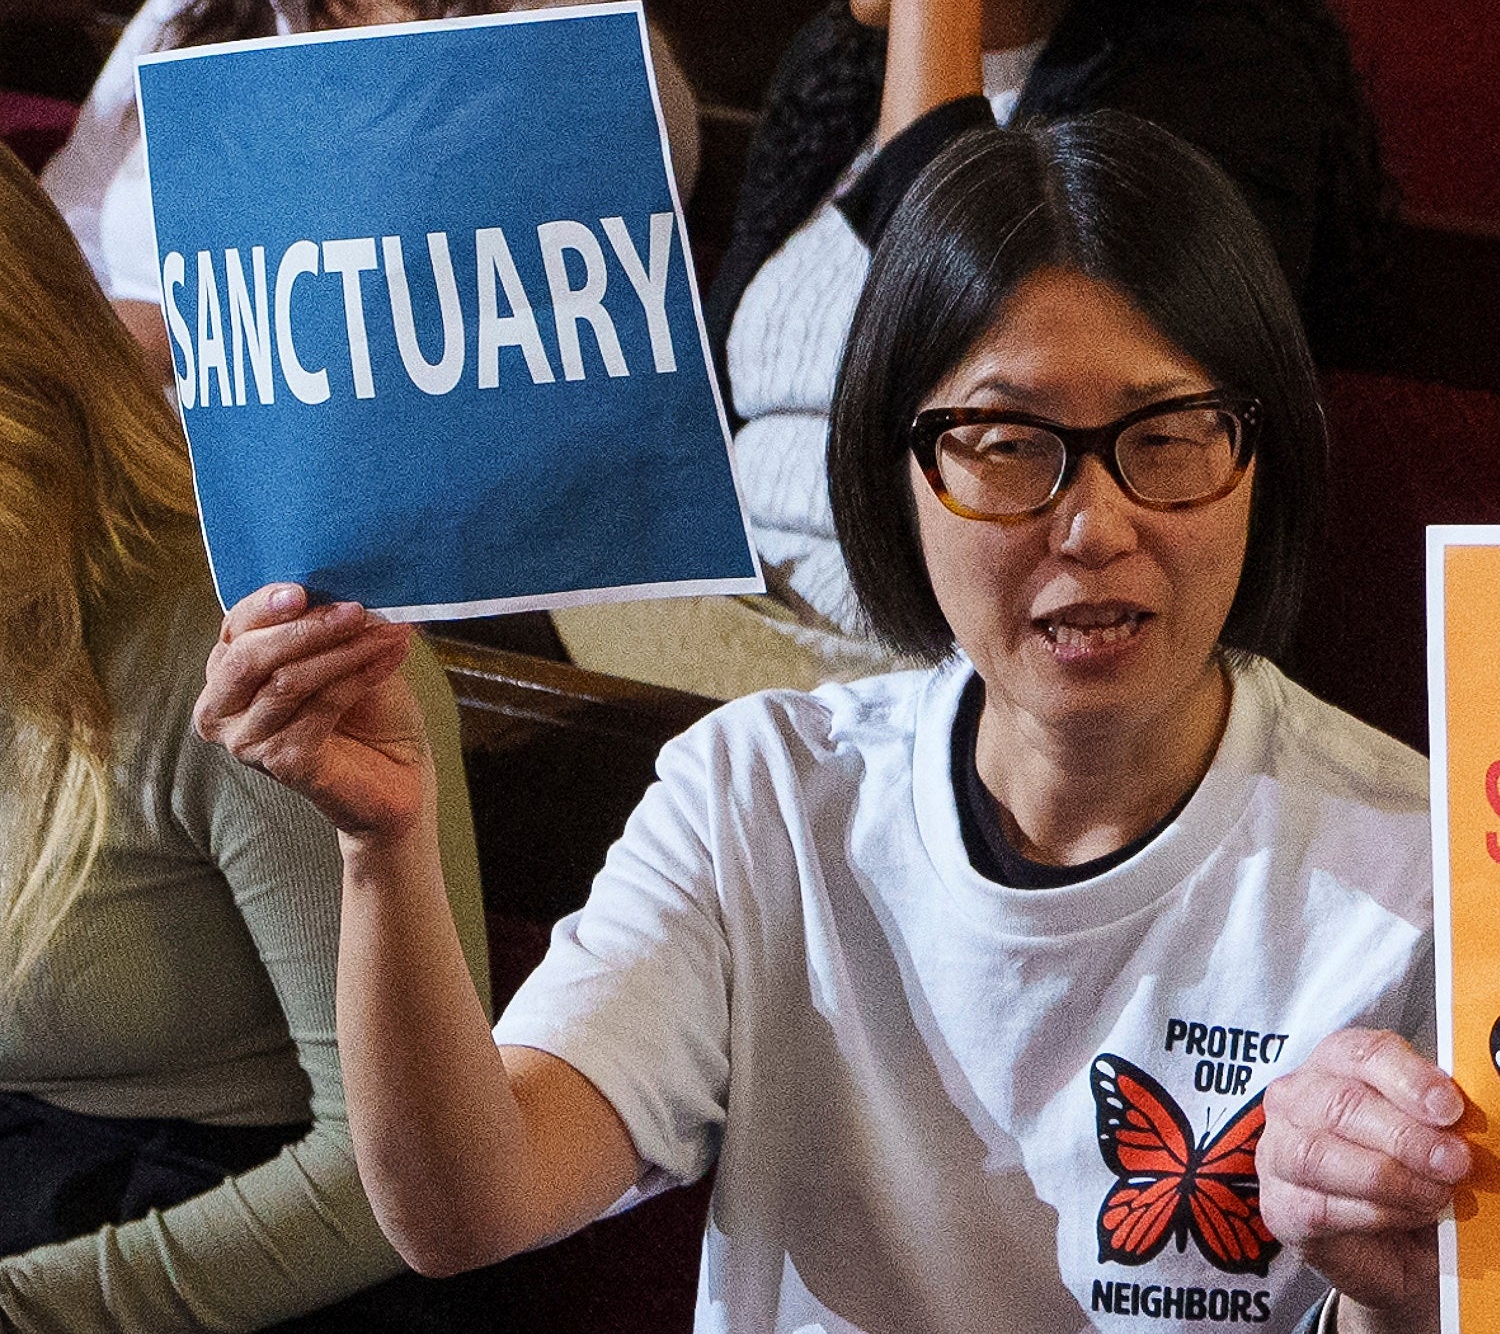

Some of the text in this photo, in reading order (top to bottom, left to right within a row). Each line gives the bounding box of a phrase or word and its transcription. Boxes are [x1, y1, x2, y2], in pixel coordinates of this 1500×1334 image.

[163, 212, 676, 409] SANCTUARY
[1164, 1018, 1290, 1064] PROTECT
[1194, 1060, 1253, 1096] OUR
[1091, 1279, 1271, 1323] NEIGHBORS
